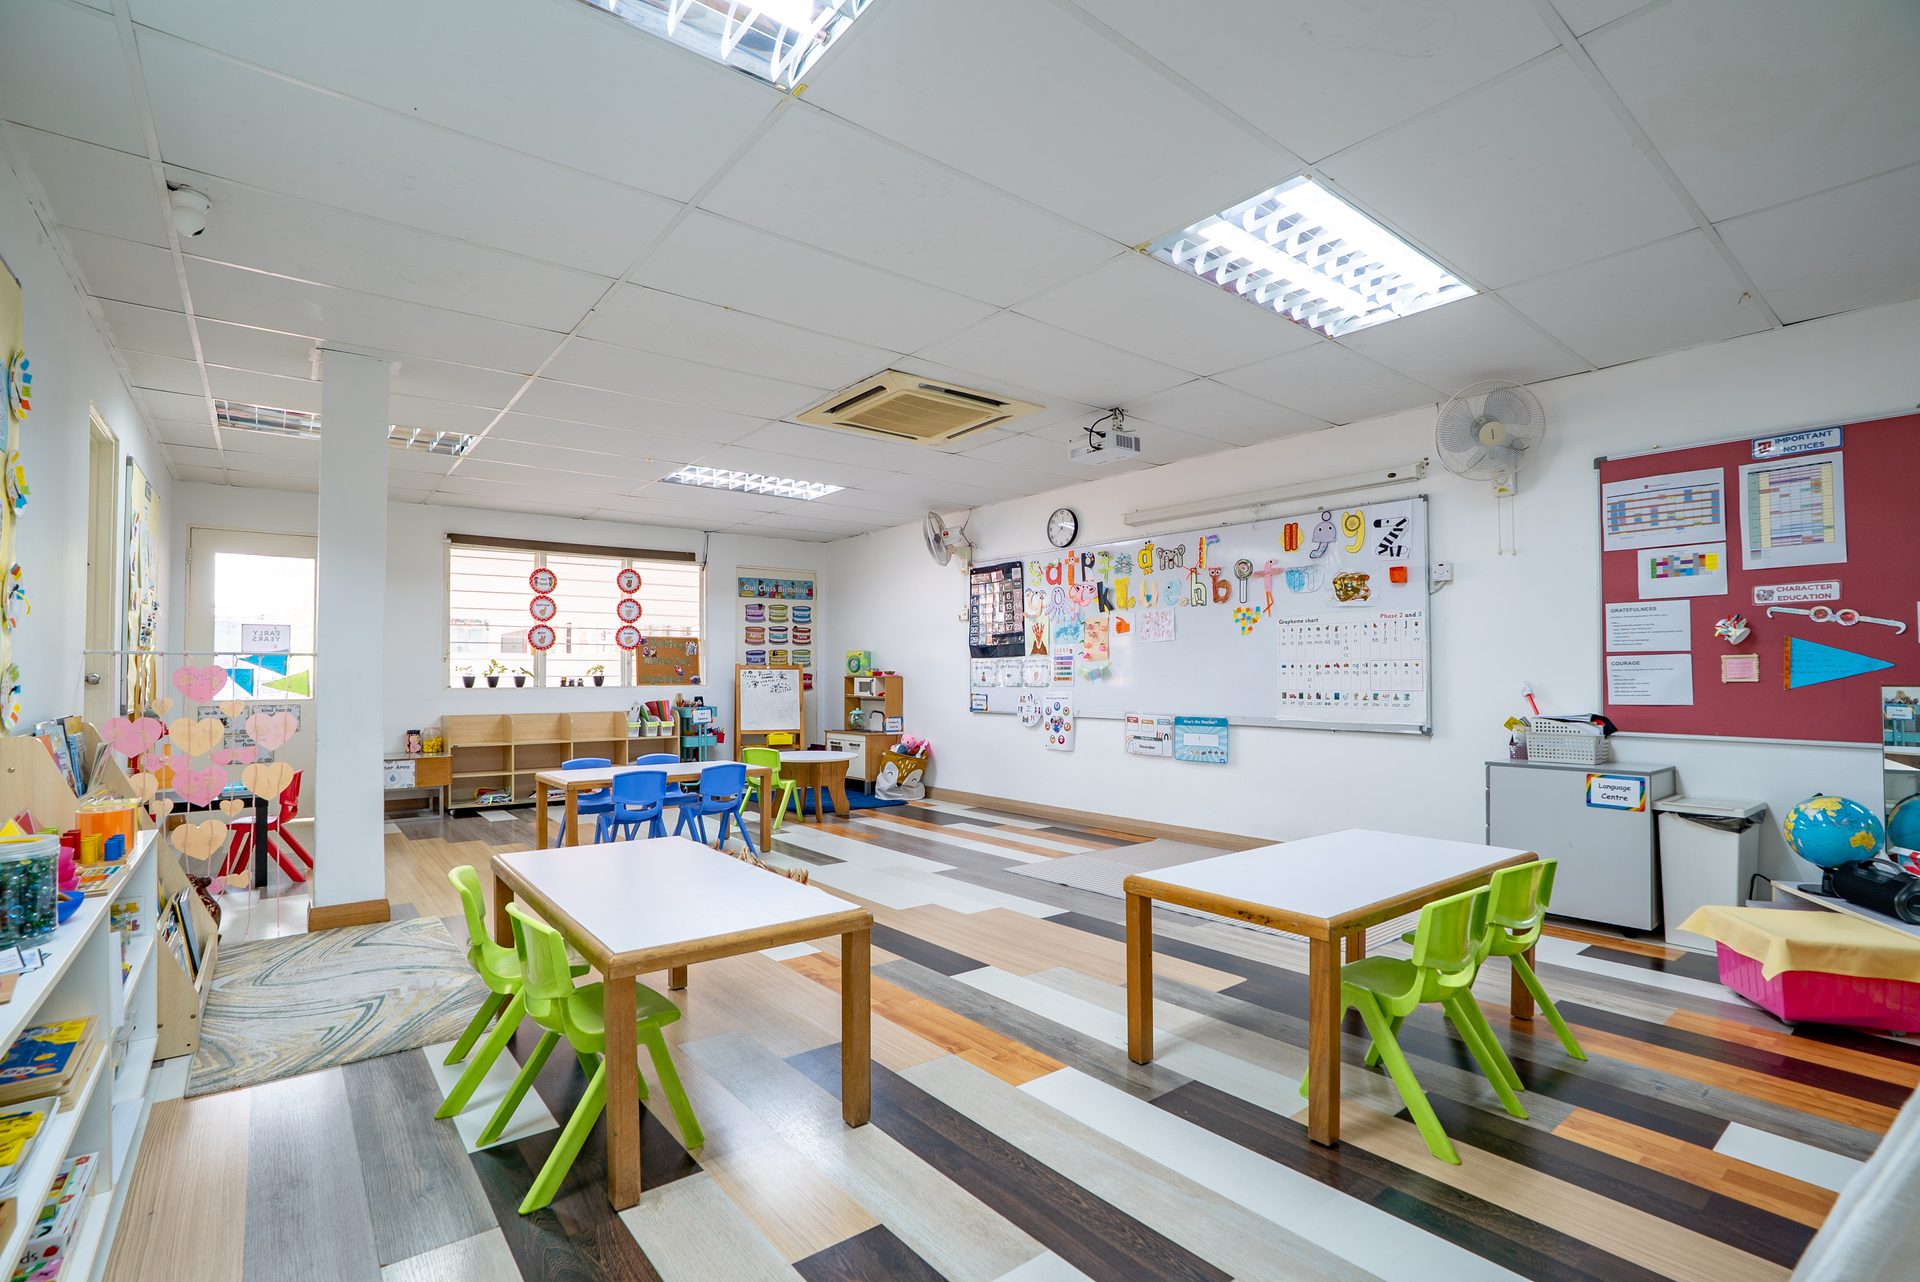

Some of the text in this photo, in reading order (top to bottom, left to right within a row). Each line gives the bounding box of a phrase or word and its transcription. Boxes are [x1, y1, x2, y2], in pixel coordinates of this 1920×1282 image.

[1774, 430, 1832, 444] IMPORTANT
[1783, 441, 1825, 452] NOTICES
[778, 586, 809, 594] Birthdays
[1776, 584, 1832, 592] CHARACTER
[1598, 782, 1631, 792] Language
[1601, 793, 1628, 801] Centre
